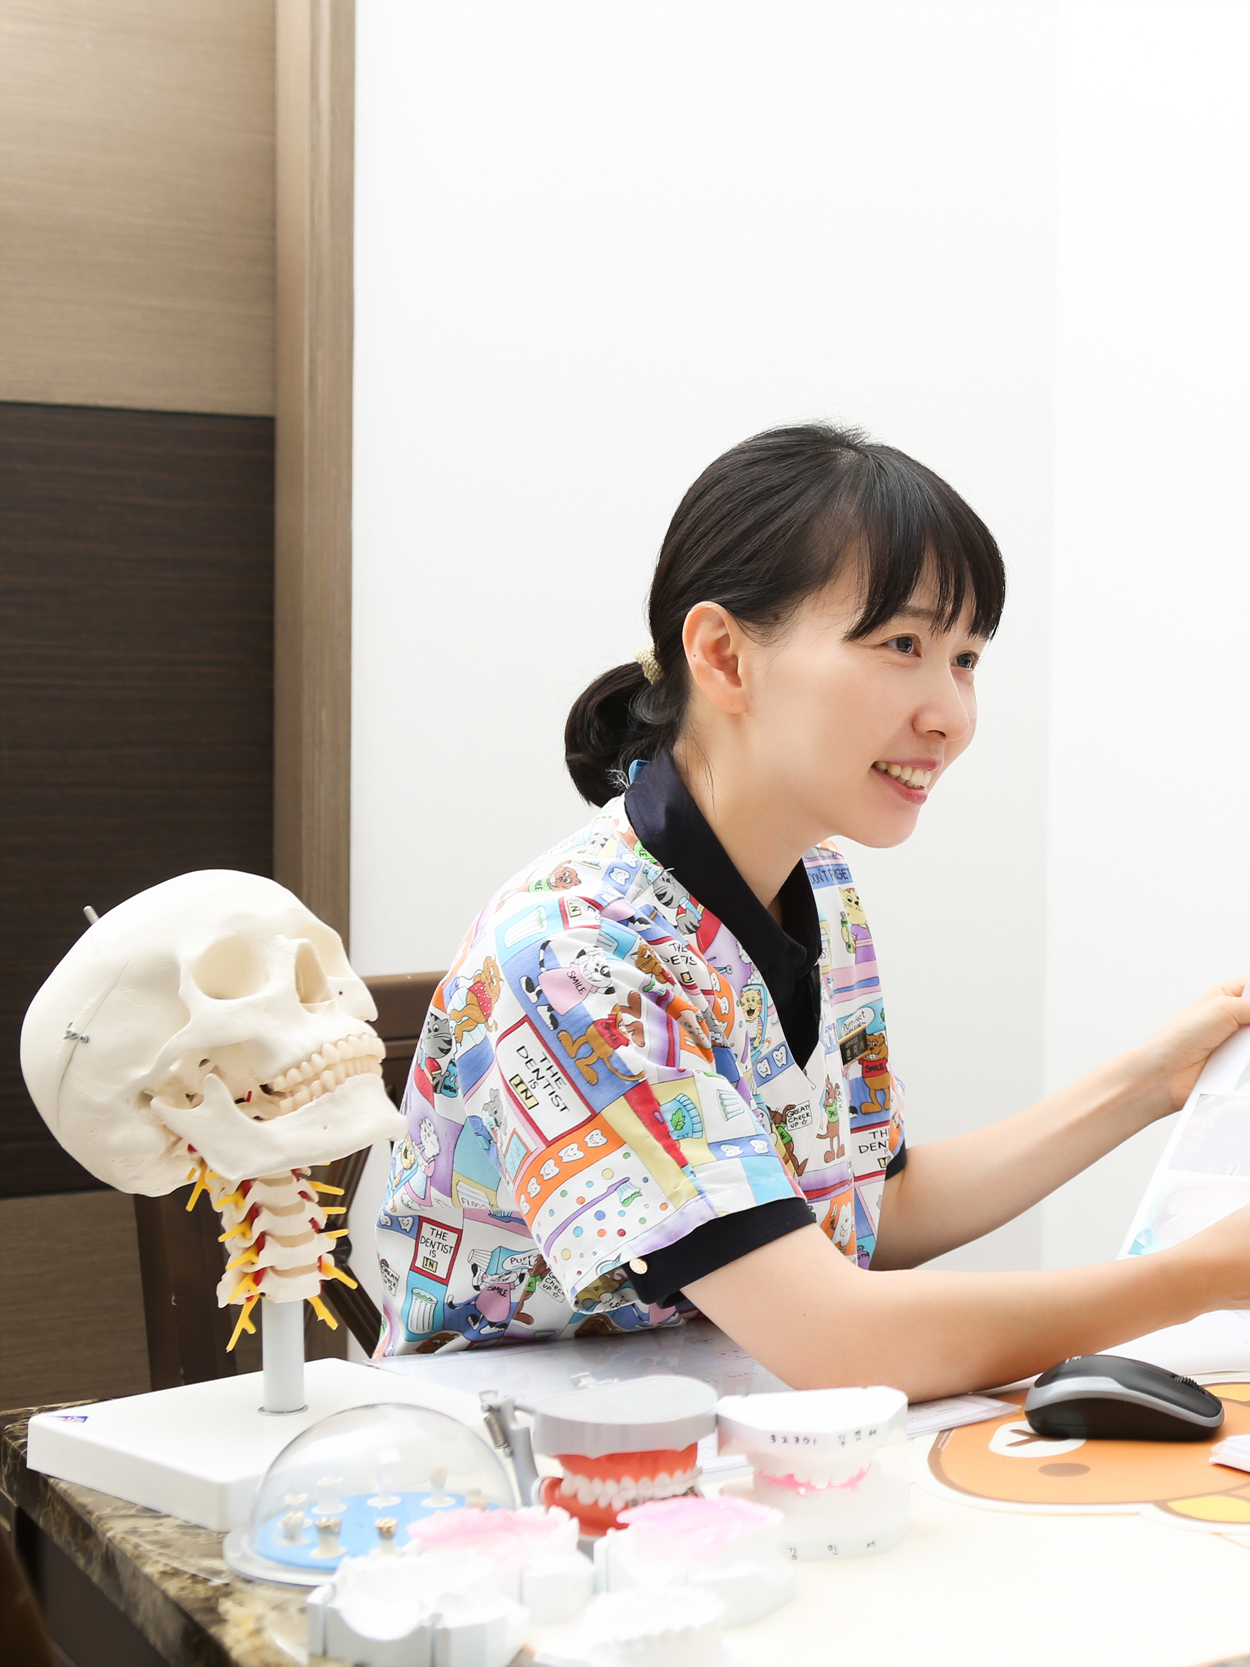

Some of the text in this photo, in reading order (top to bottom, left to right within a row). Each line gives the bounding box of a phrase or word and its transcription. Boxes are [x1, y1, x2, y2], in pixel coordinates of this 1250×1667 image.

[566, 969, 588, 995] SMILE
[601, 1021, 619, 1043] SMILE
[540, 1052, 567, 1090] THE
[864, 1062, 885, 1074] SMILE
[516, 1045, 571, 1113] DENTIST
[528, 1078, 540, 1090] IS
[513, 1081, 533, 1101] IN
[430, 1226, 449, 1242] THE
[419, 1235, 454, 1255] DENTIST
[428, 1249, 437, 1258] IS
[423, 1259, 434, 1270] IN
[487, 1285, 508, 1298] SMILE
[769, 1434, 817, 1446] 32301
